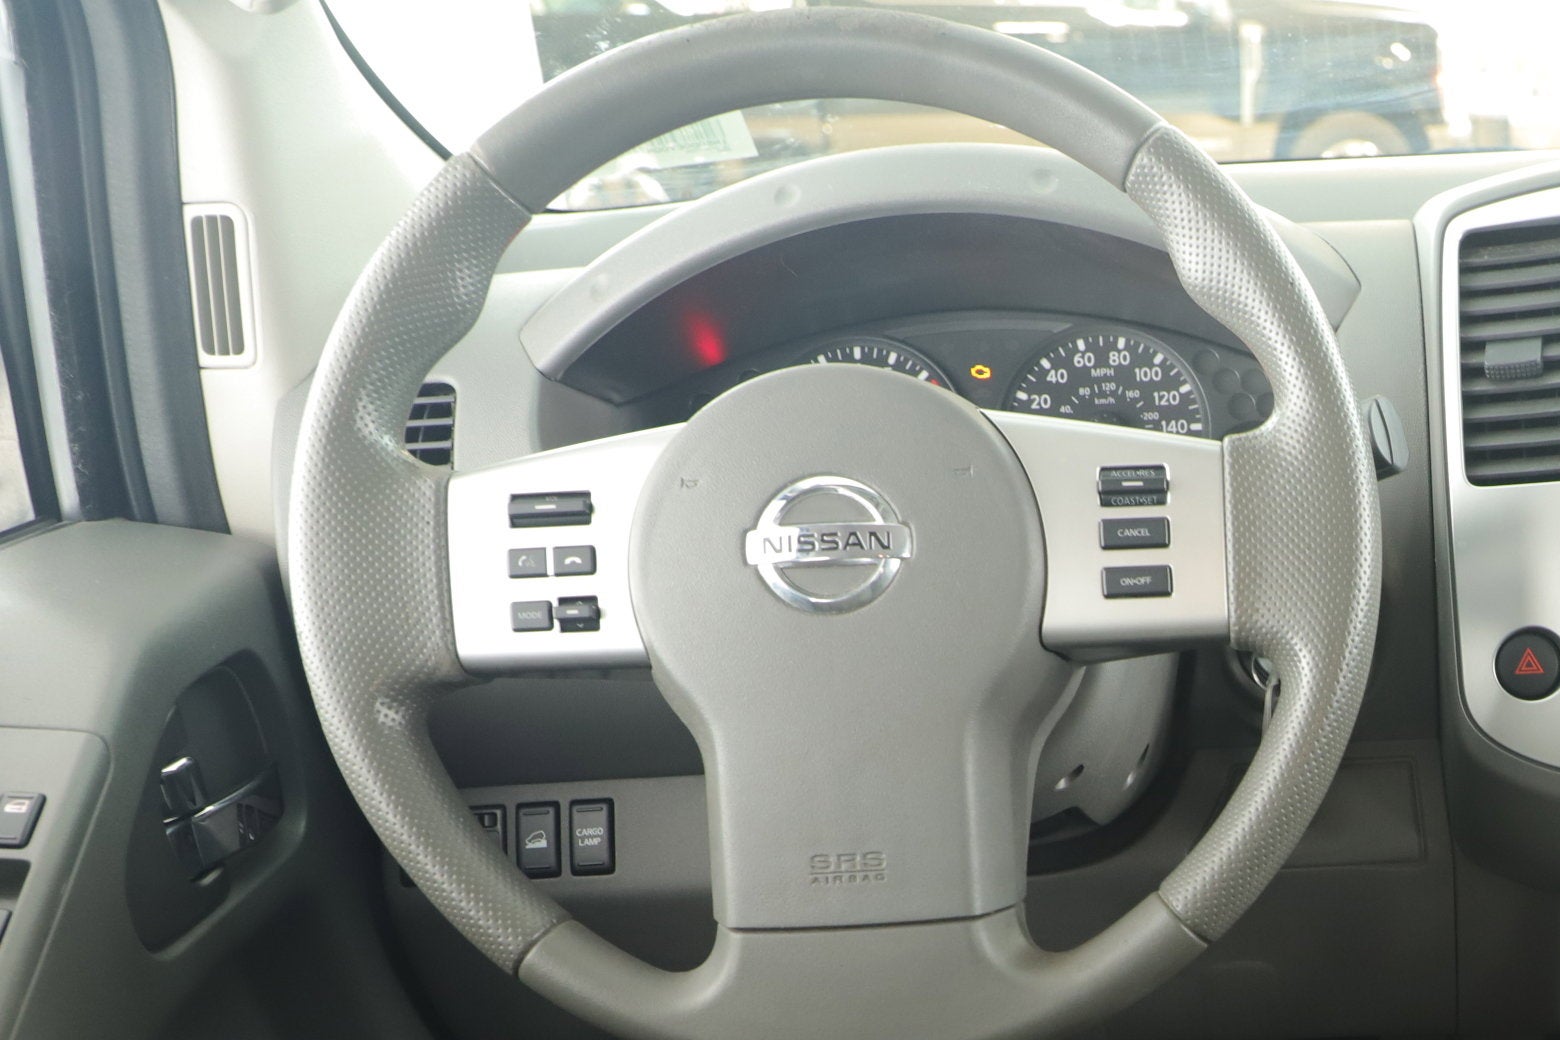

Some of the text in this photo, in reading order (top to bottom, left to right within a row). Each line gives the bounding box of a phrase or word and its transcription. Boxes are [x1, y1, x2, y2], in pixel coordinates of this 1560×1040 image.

[1073, 352, 1095, 368] 60
[1109, 351, 1131, 366] 80
[1046, 369, 1068, 384] 40
[1091, 368, 1115, 378] MPH
[1134, 367, 1163, 382] 100
[1078, 387, 1091, 396] 80
[1102, 383, 1116, 391] 120
[1125, 390, 1140, 398] 160
[1153, 391, 1180, 406] 120
[1030, 394, 1051, 410] 20
[1094, 397, 1116, 406] km/h
[1059, 405, 1071, 414] 40
[1142, 412, 1160, 421] 200
[1160, 420, 1188, 434] 140
[1117, 527, 1151, 537] CANCEL
[762, 531, 893, 554] NISSAN
[576, 827, 604, 838] CARGO
[578, 837, 601, 847] LAMP
[810, 851, 887, 870] SRS
